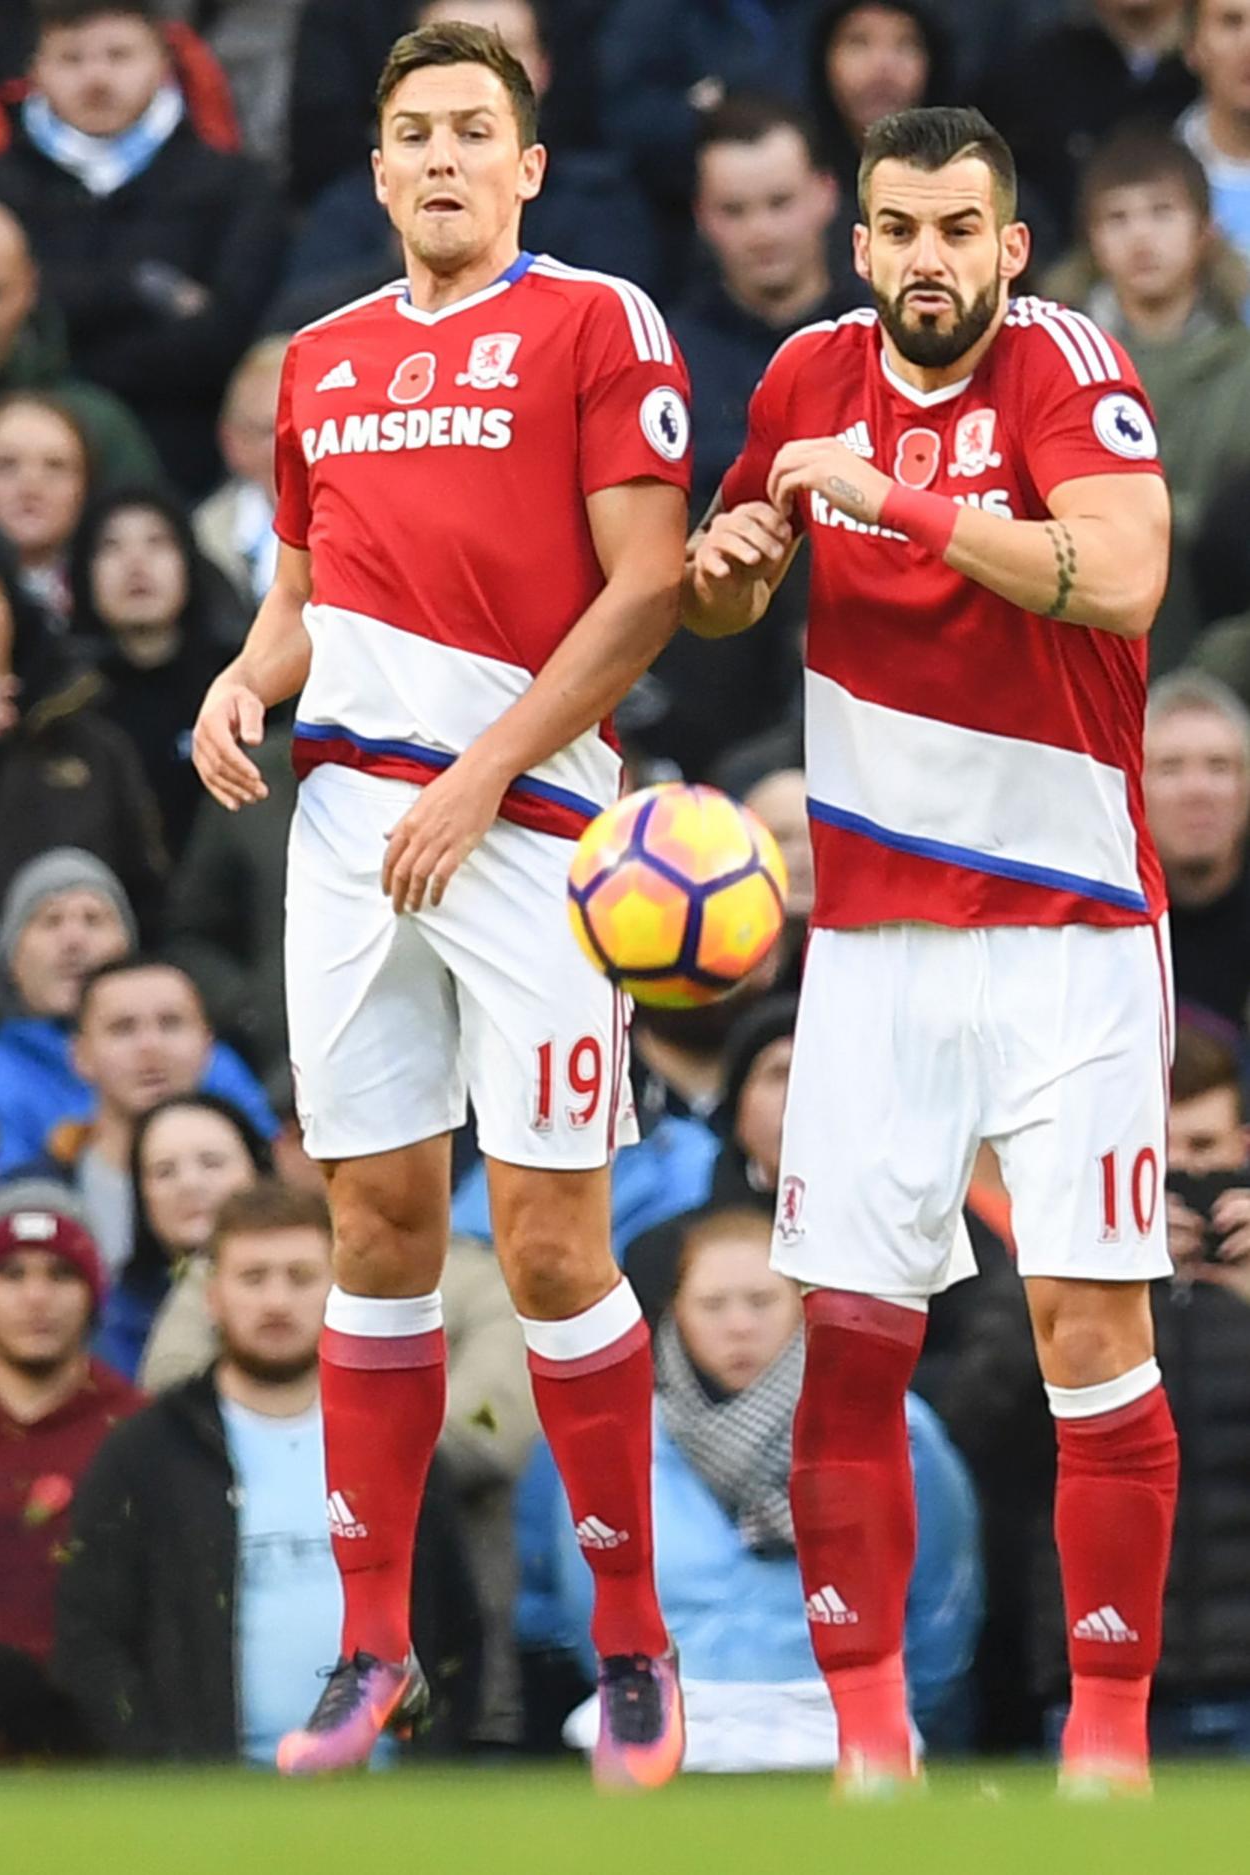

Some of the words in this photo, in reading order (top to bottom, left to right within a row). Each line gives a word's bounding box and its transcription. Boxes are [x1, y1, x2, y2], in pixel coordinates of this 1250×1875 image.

[302, 405, 514, 465] RAMSDENS
[533, 1035, 603, 1129] 19
[1098, 1146, 1158, 1240] 10
